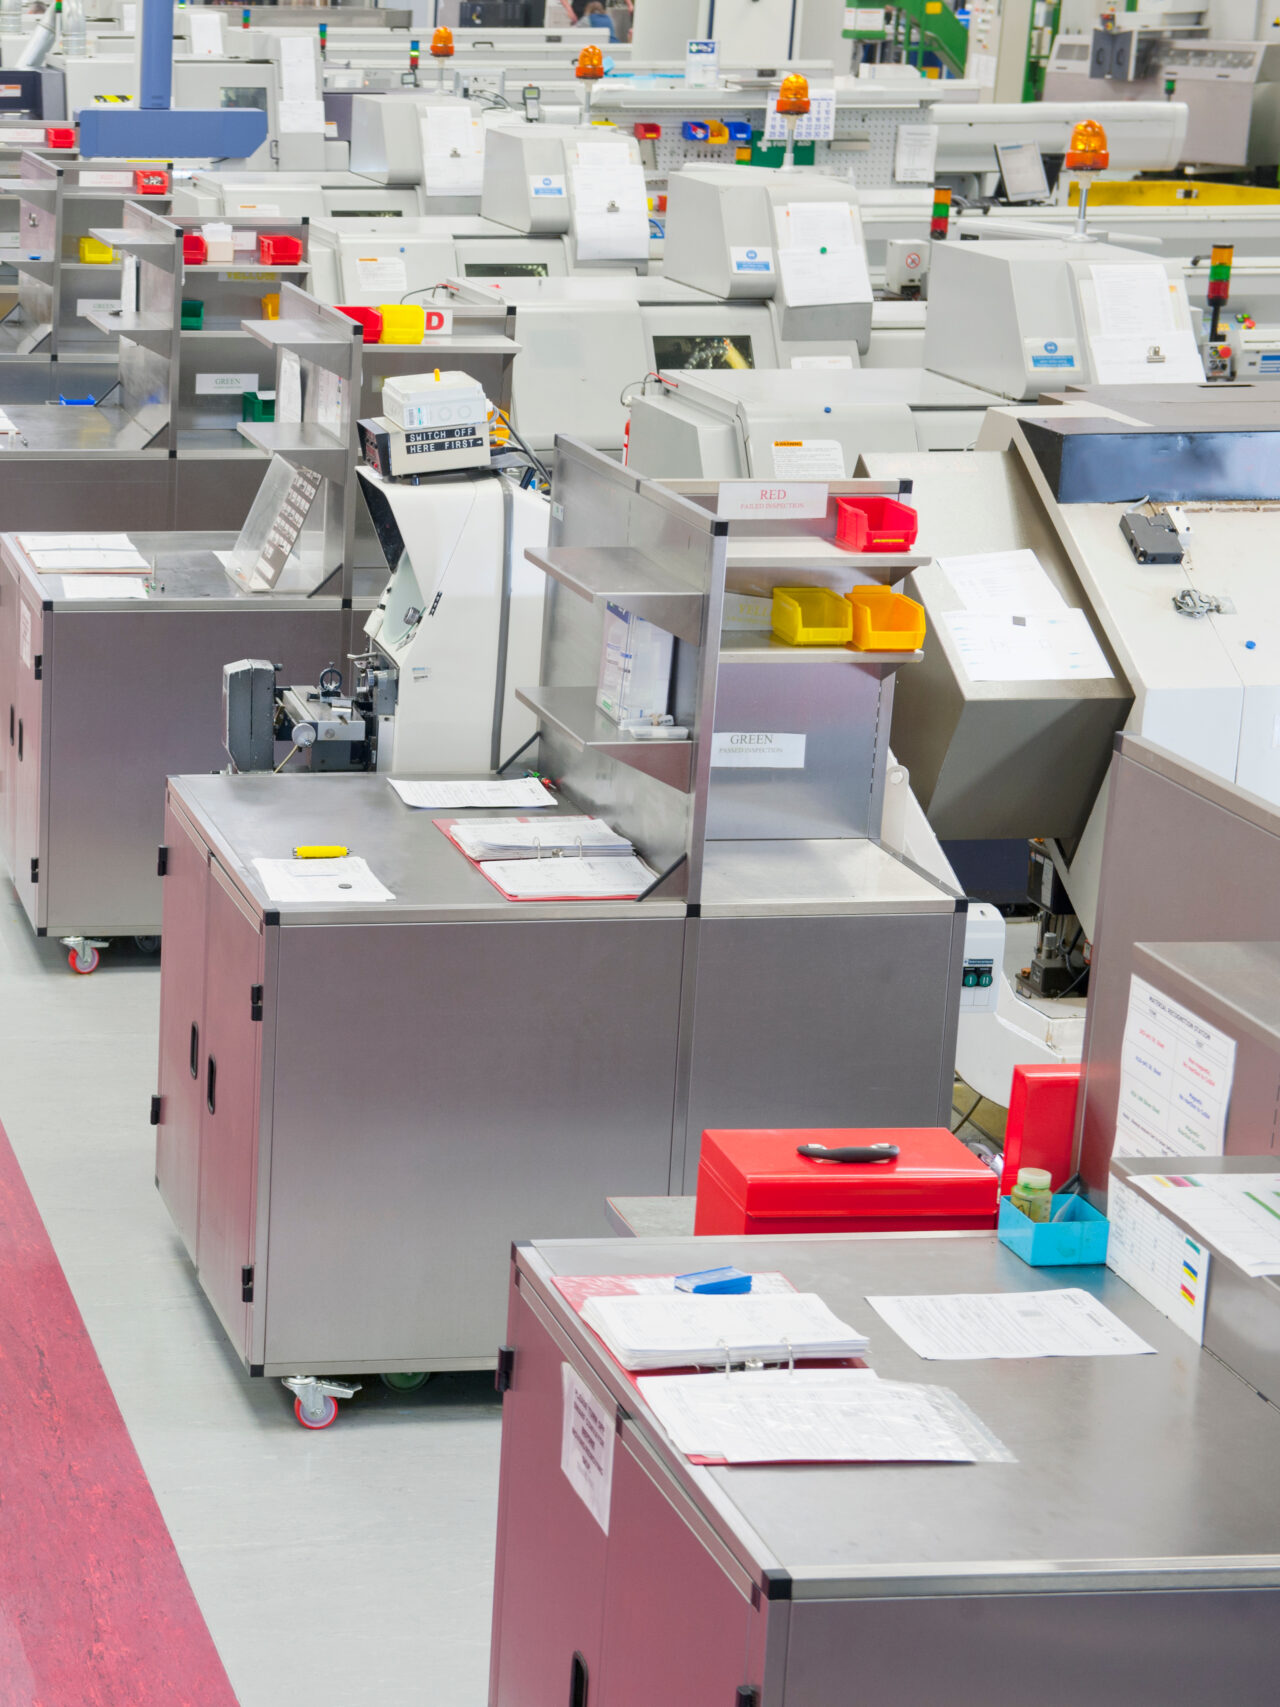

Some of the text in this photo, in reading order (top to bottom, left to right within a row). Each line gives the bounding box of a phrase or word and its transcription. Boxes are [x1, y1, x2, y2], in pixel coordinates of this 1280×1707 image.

[409, 427, 473, 442] SWITCH OFF
[409, 439, 474, 453] HERE FIRST
[760, 489, 787, 500] RED
[730, 734, 774, 745] GREEN
